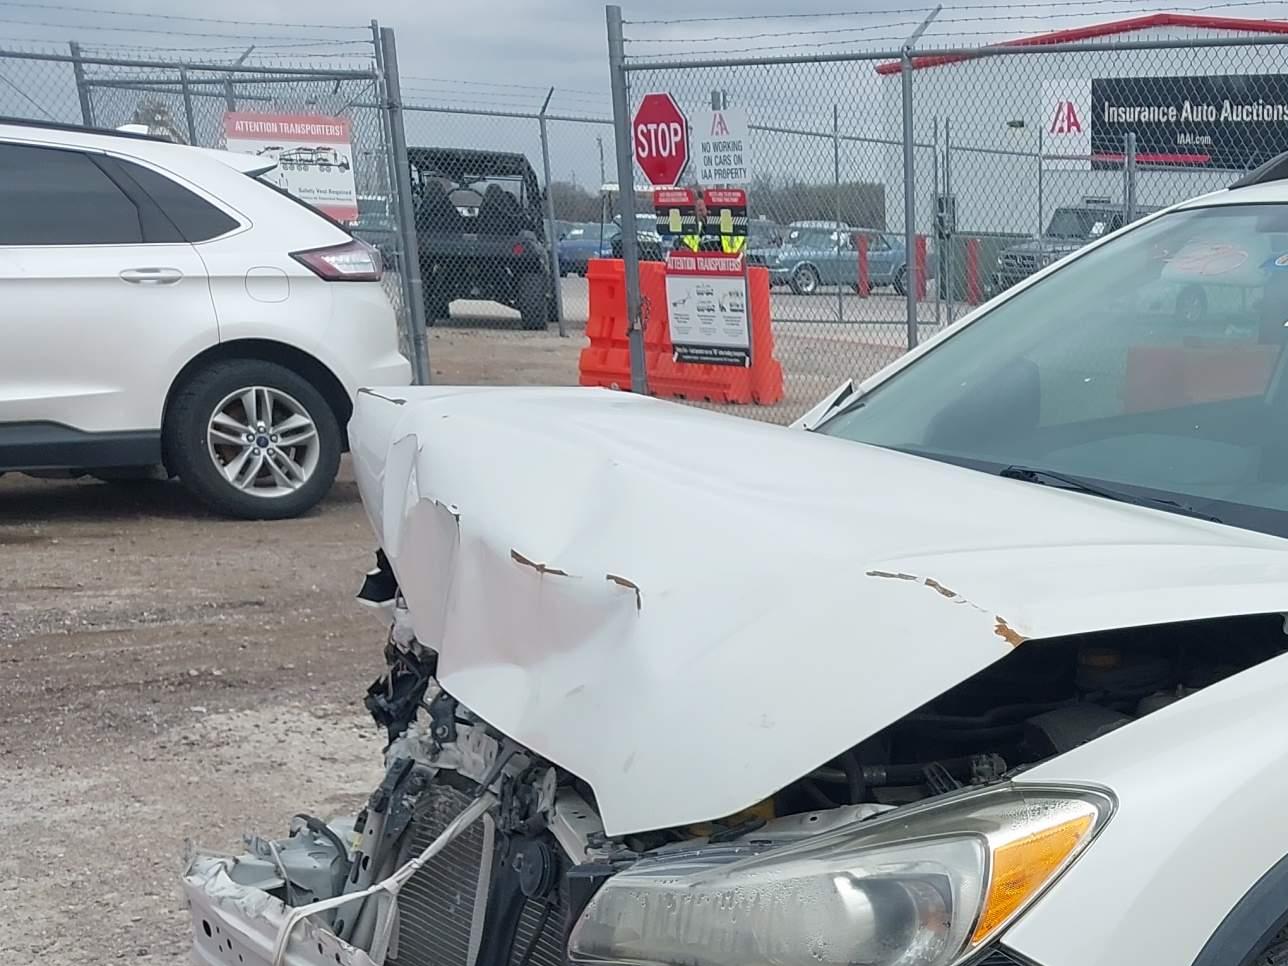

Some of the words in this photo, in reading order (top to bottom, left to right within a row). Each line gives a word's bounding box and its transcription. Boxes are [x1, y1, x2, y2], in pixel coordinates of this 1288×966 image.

[1104, 101, 1177, 122] Insurance
[1180, 100, 1216, 122] Auto
[235, 120, 278, 133] ATTENTION
[279, 122, 343, 136] TRANSPORTERS!
[637, 122, 682, 159] STOP
[701, 142, 711, 153] NO
[712, 140, 743, 152] WORKING
[703, 155, 713, 167] ON
[714, 154, 732, 166] CARS
[733, 153, 743, 165] ON
[701, 169, 713, 180] IAA
[714, 167, 747, 179] PROPERTY
[667, 256, 696, 270] ATTENTION
